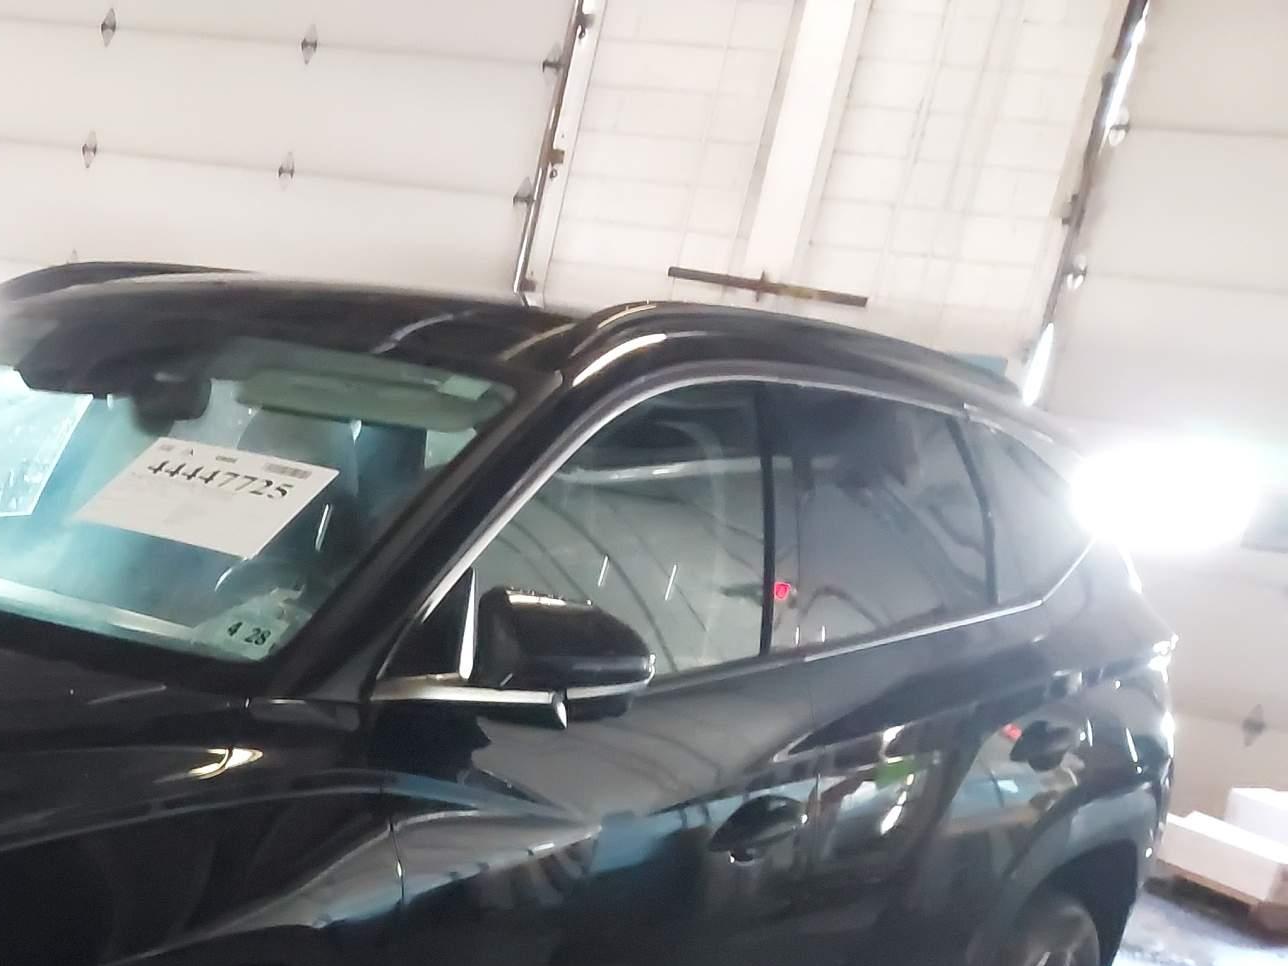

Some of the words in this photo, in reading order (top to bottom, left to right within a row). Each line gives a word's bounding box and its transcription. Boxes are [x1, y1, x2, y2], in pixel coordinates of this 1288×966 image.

[148, 460, 294, 499] 44447725
[227, 621, 243, 637] 4
[244, 627, 271, 646] 28
